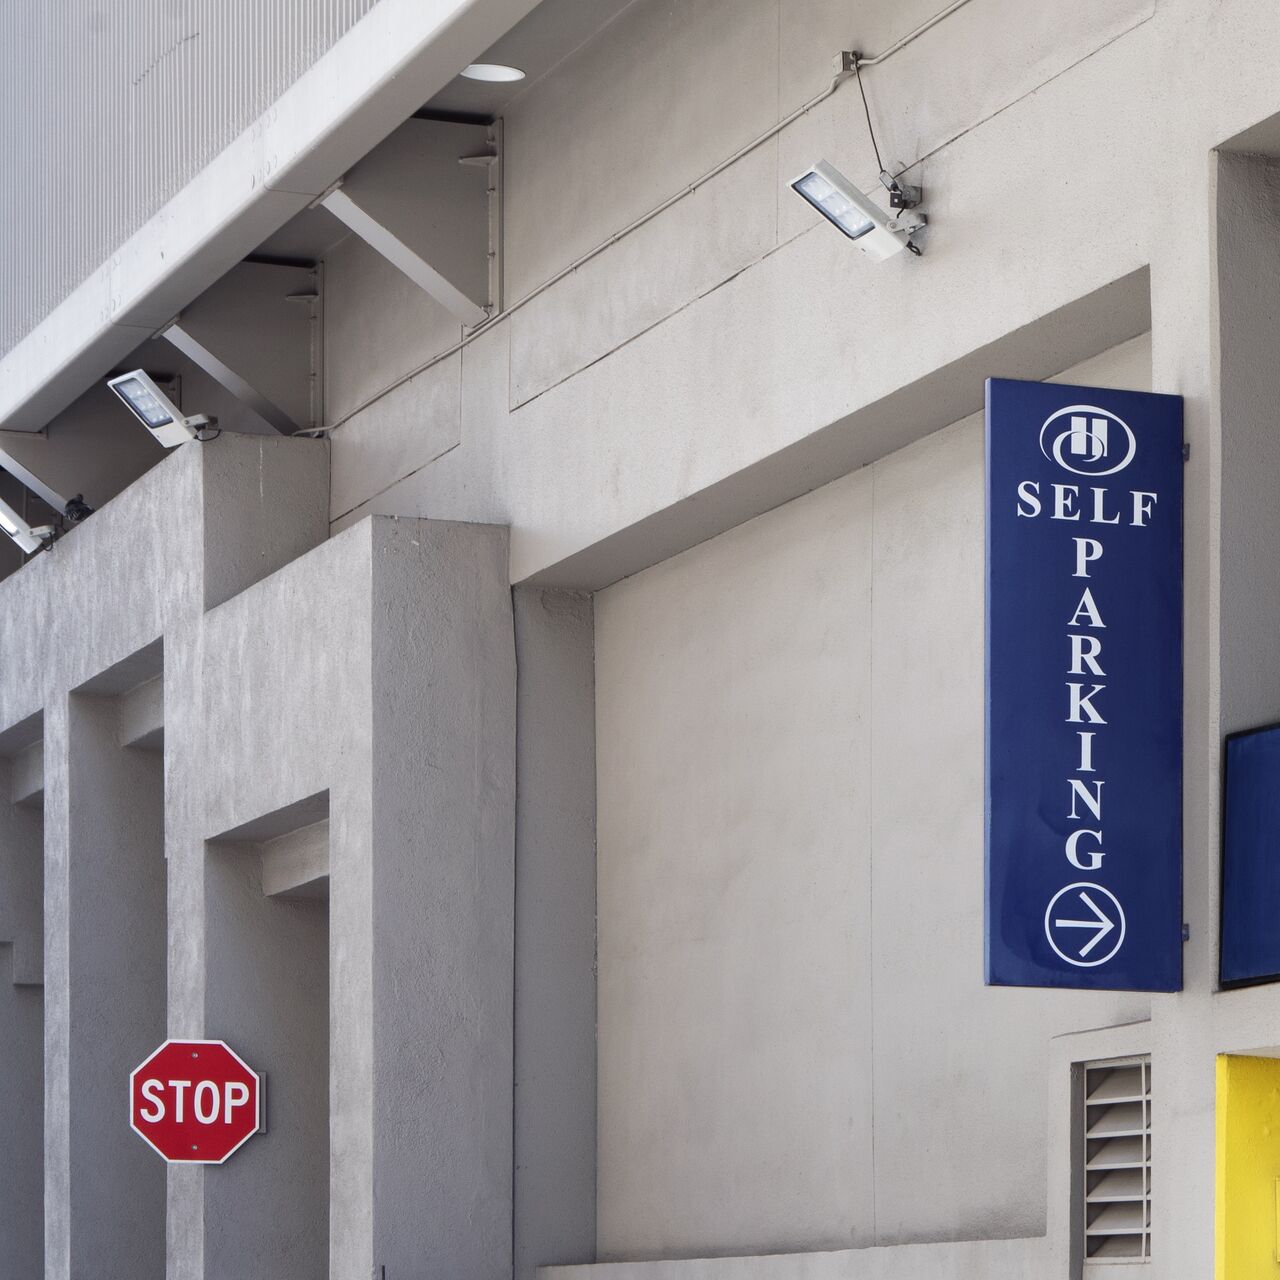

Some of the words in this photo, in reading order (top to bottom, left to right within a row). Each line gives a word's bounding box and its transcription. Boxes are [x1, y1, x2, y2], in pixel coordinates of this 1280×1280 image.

[1017, 481, 1157, 526] SELF
[1065, 537, 1107, 870] PARKING
[140, 1078, 250, 1125] STOP
